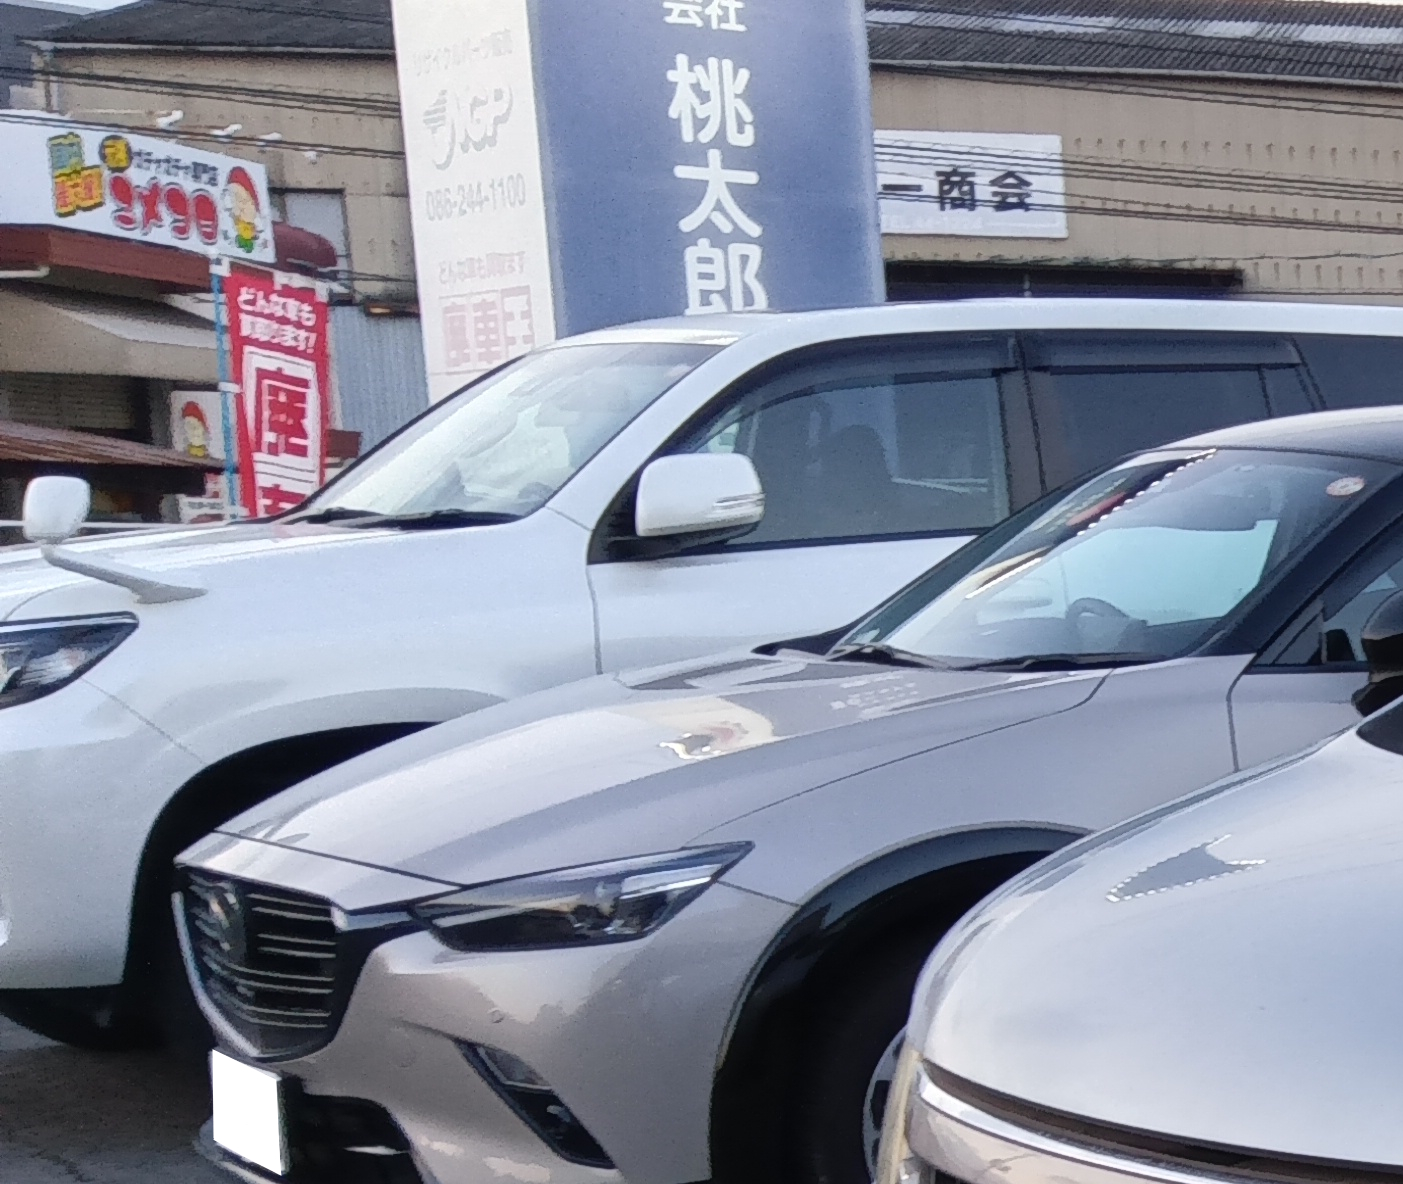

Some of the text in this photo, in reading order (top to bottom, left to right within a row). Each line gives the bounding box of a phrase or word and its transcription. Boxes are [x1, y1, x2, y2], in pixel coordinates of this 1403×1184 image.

[425, 173, 526, 222] 086-244-1100
[666, 53, 769, 316] 桃太郎
[236, 285, 317, 327] どんな車も
[442, 284, 536, 369] 廃車王
